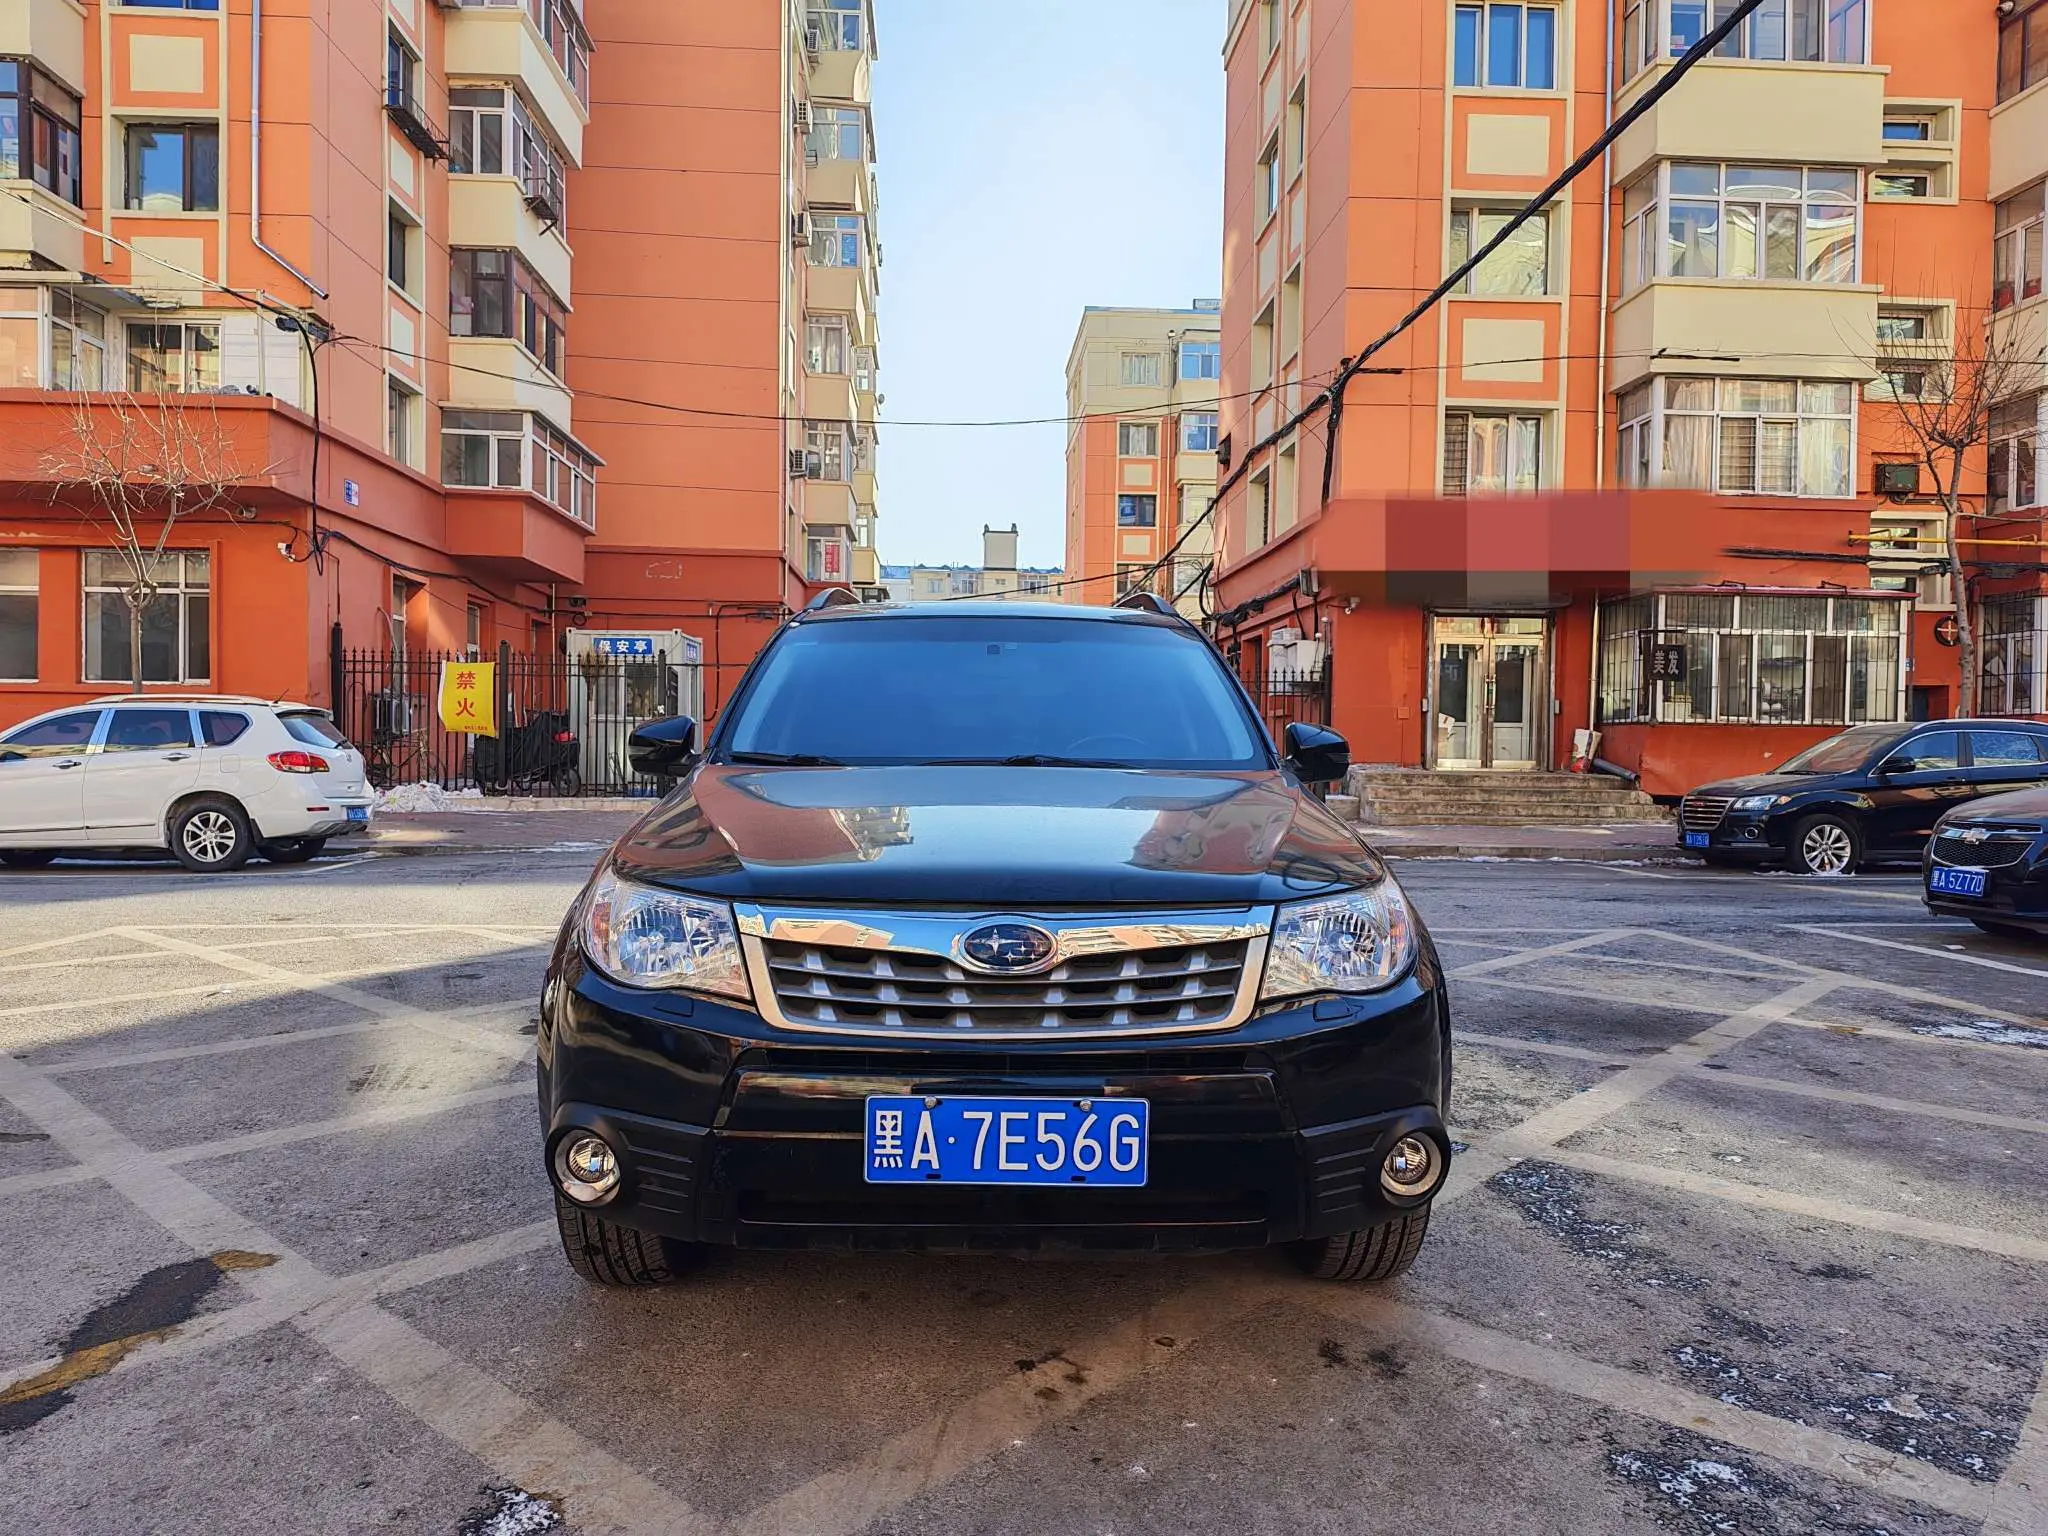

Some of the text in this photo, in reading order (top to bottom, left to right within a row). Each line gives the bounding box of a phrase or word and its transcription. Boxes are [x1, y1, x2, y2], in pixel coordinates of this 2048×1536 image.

[599, 639, 648, 653] 保安亭
[1652, 650, 1679, 675] 美发
[456, 671, 476, 717] 禁火
